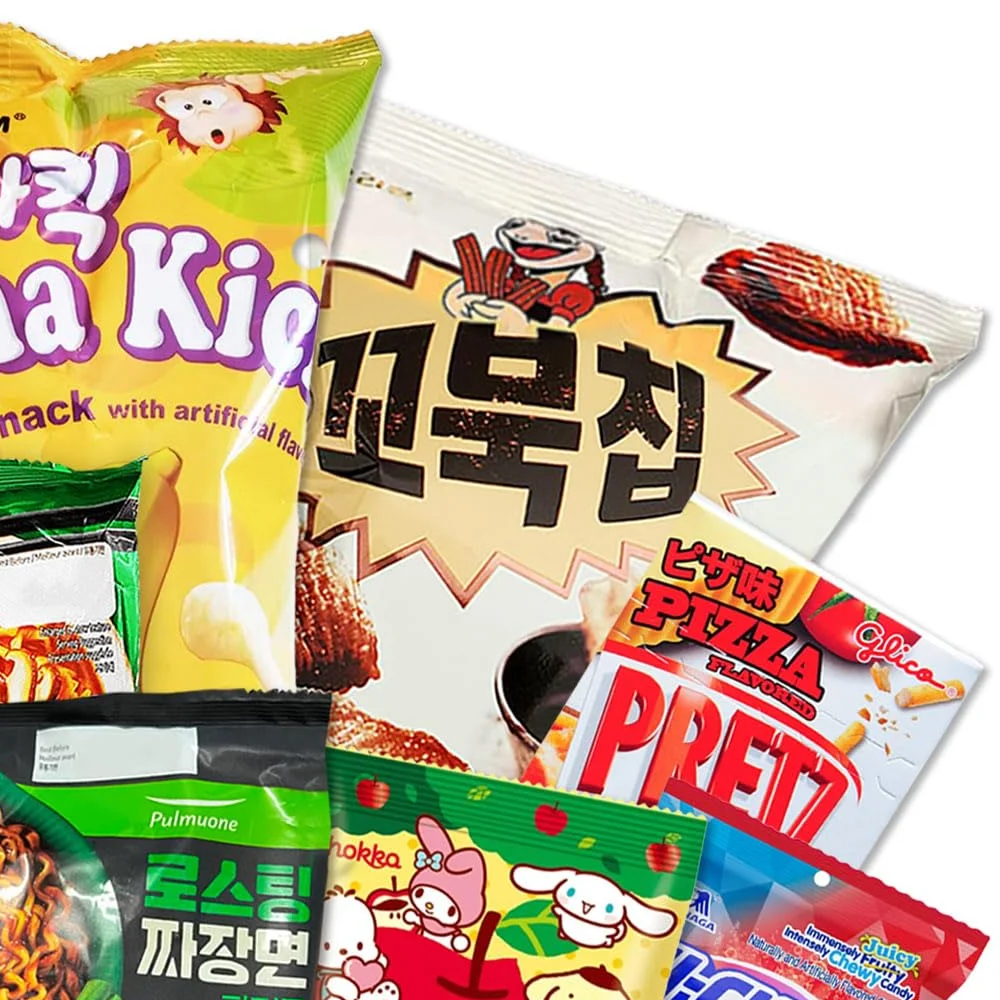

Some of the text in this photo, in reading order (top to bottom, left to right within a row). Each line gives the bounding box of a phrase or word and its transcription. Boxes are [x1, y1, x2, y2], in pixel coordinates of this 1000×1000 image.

[121, 226, 319, 392] Kic
[108, 400, 165, 419] with
[315, 321, 706, 528] 꼬북칩
[662, 537, 784, 612] ピザ味
[631, 580, 826, 702] PIZZA
[854, 621, 946, 691] Glico
[706, 654, 818, 721] FLAVORED
[577, 664, 850, 846] PRETZ
[149, 810, 239, 832] Pulmuone
[329, 834, 402, 869] hokka
[144, 854, 312, 924] 로스팅
[137, 918, 311, 989] 짜장면
[748, 934, 784, 960] Naturally
[783, 953, 801, 968] and
[784, 927, 830, 958] Intensely
[828, 949, 883, 988] Chewy
[806, 924, 906, 985] Immensely Fruity
[862, 938, 920, 970] Juicy
